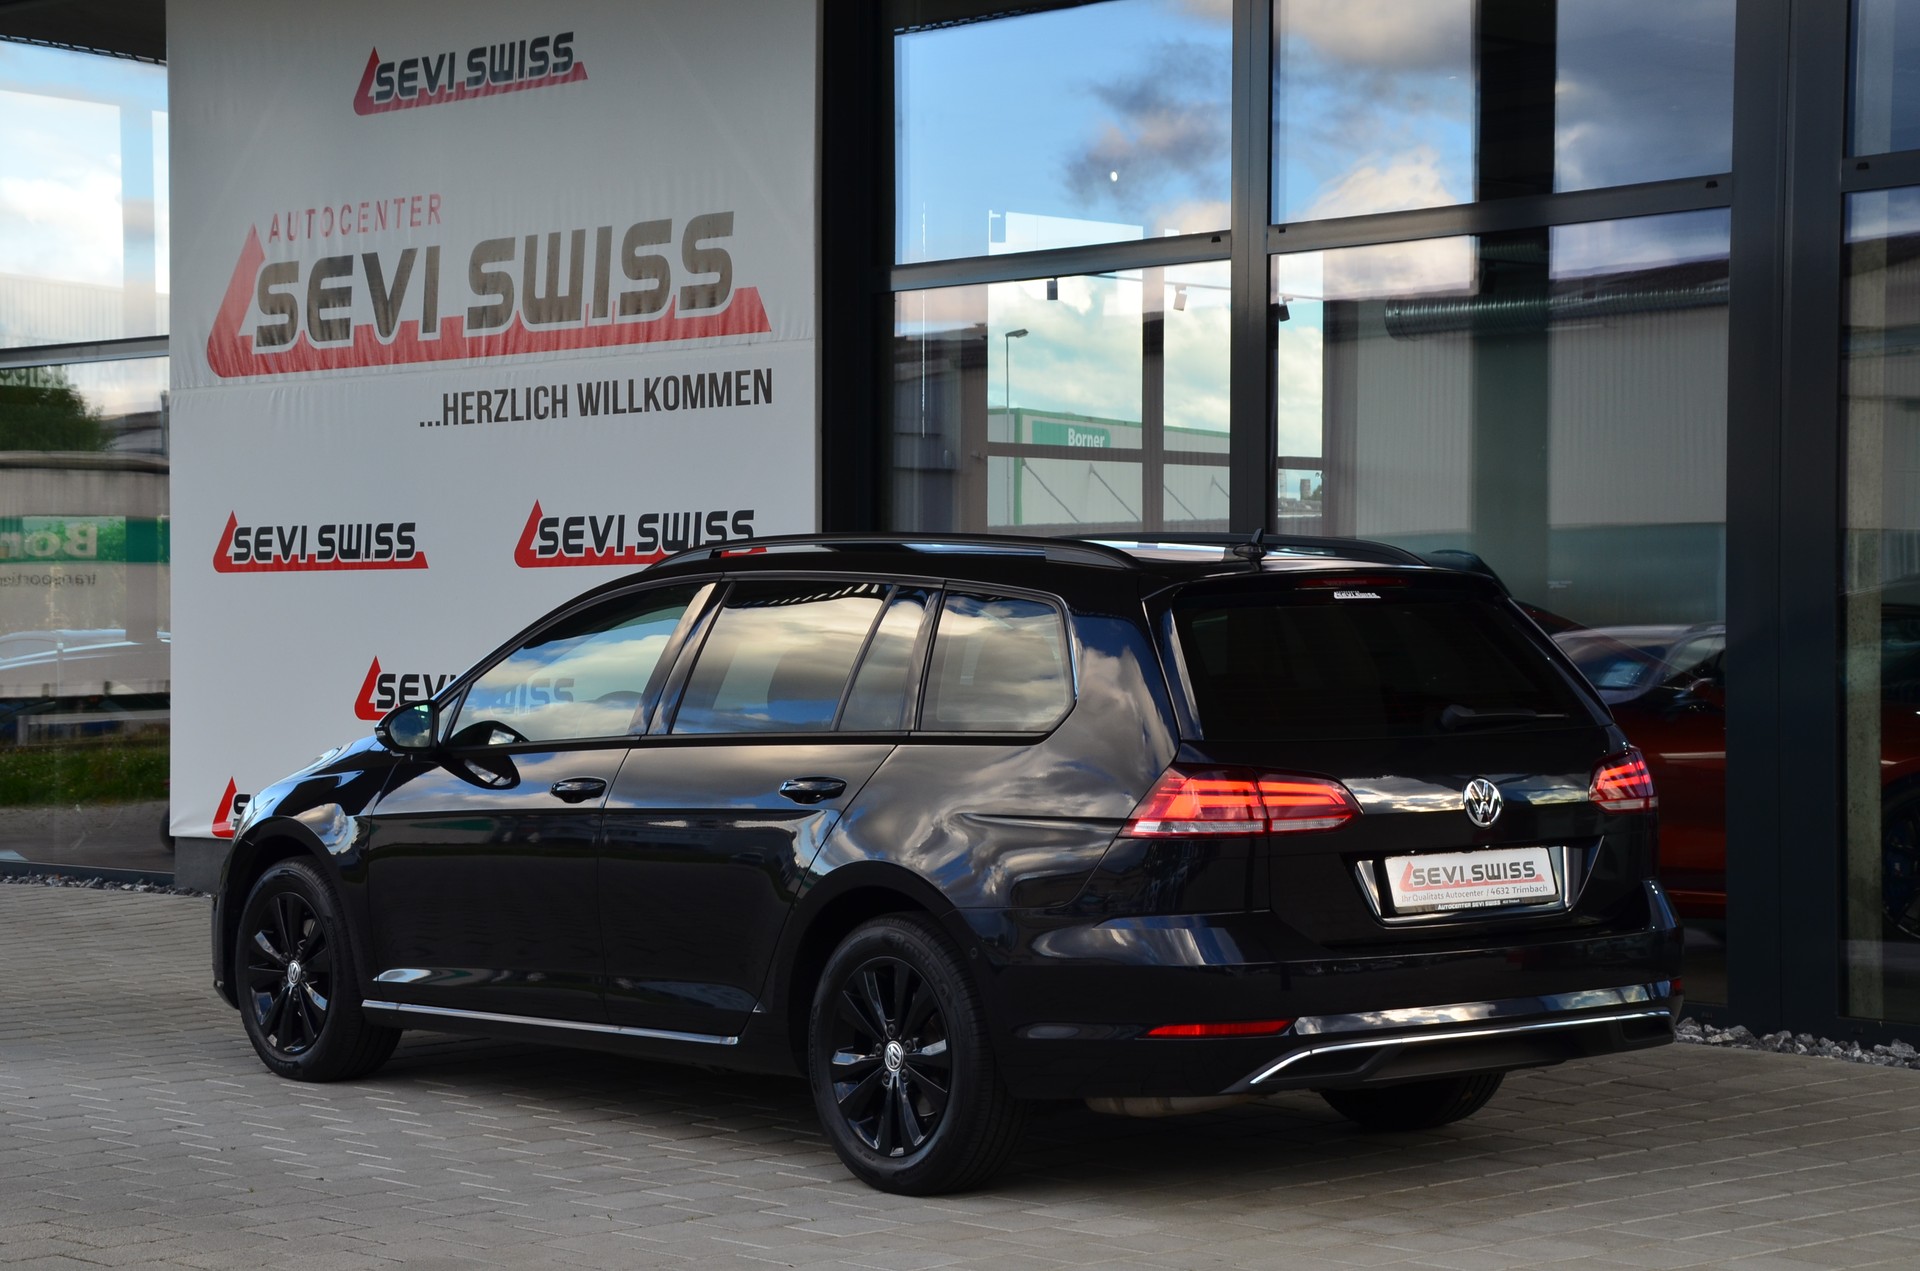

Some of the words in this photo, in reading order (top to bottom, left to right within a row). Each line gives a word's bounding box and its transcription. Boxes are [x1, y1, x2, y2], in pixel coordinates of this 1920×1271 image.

[375, 52, 456, 101] SEVI
[466, 31, 574, 88] SWISS
[268, 193, 442, 243] AUTOCENTER
[256, 245, 441, 347] SEVI
[466, 211, 735, 330] SWISS
[419, 384, 568, 427] ...HERZLICH
[577, 368, 773, 416] WILLKOMMEN
[1067, 427, 1105, 448] Borner
[233, 525, 308, 562] SEVI
[316, 522, 416, 559] SWISS
[537, 514, 626, 555] SEVI
[636, 509, 755, 555] SWISS
[1412, 865, 1465, 887] SEVI
[1471, 861, 1536, 882] SWISS
[1445, 889, 1484, 899] Autocenter
[1490, 887, 1510, 896] 4632
[1512, 884, 1548, 894] Trimbach
